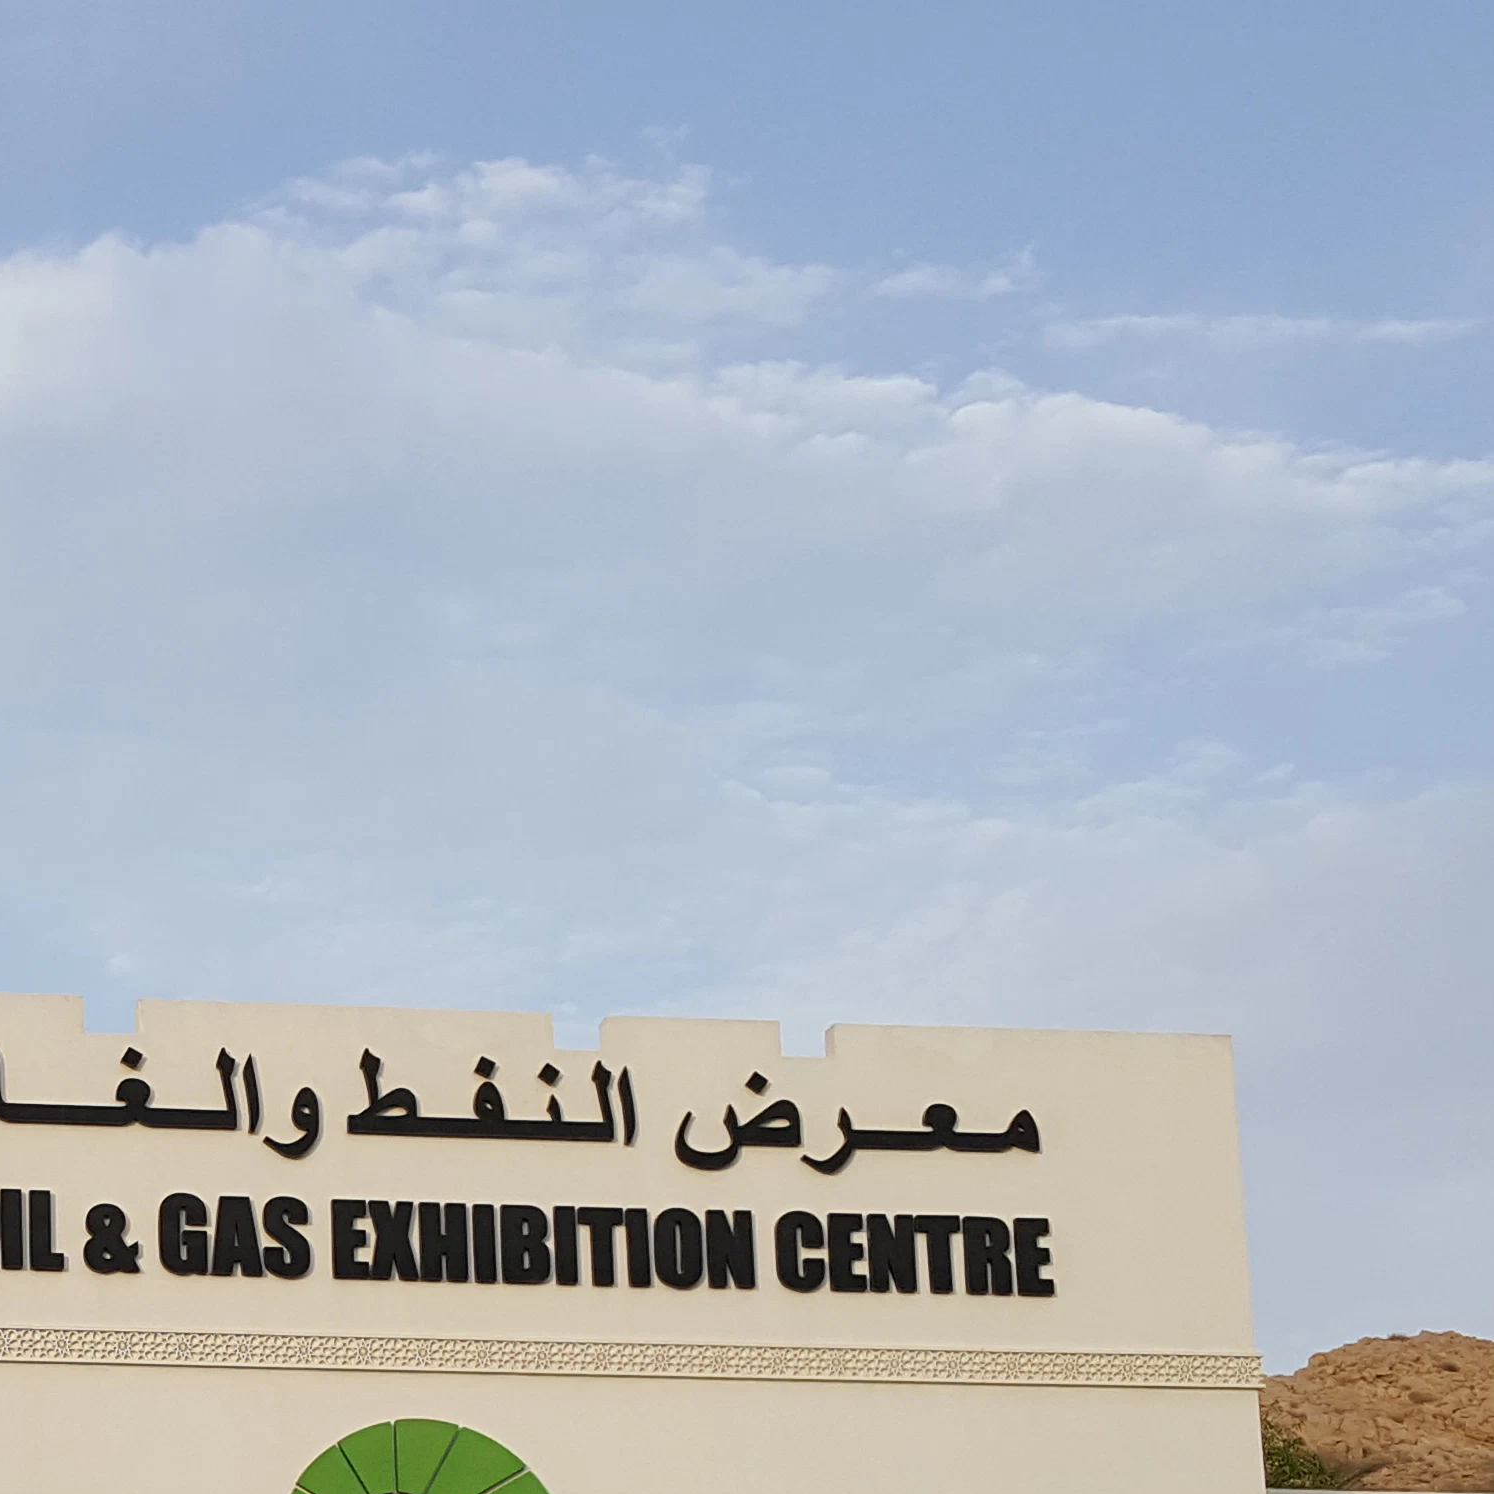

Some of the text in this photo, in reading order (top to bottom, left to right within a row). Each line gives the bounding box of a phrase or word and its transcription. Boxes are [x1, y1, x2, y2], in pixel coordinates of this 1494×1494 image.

[346, 1047, 637, 1147] النفط
[674, 1070, 1041, 1177] معرض
[82, 1202, 143, 1276] &
[158, 1192, 312, 1281] GAS
[331, 1198, 757, 1292] EXHIBITION
[773, 1210, 1056, 1299] CENTRE
